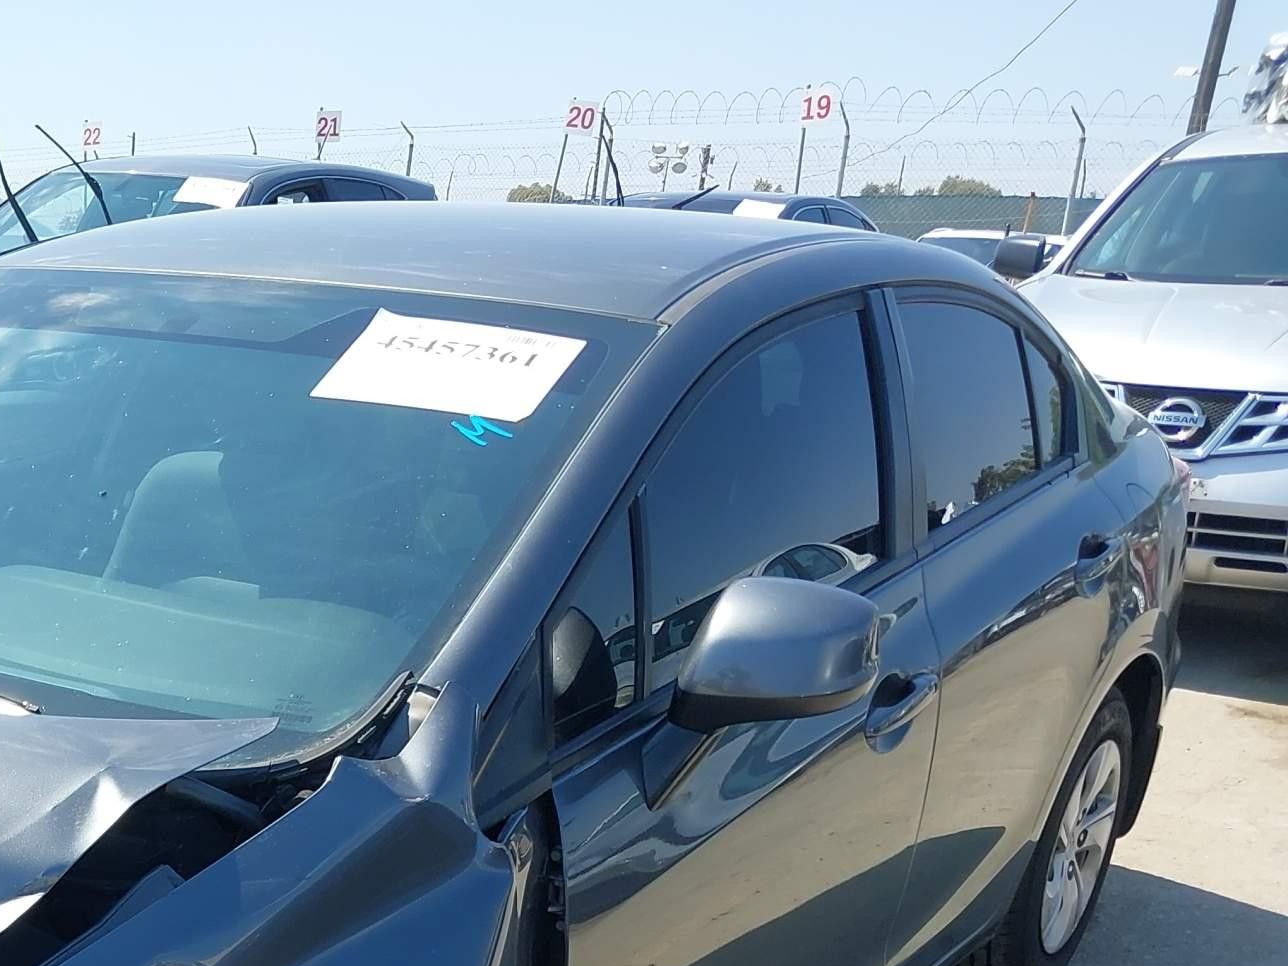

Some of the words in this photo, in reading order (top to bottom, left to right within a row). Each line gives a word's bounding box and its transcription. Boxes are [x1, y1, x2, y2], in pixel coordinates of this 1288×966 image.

[566, 105, 595, 130] 20
[801, 94, 832, 121] 19
[83, 127, 101, 146] 22
[316, 117, 340, 138] 21
[377, 335, 539, 367] 45457361
[1152, 414, 1199, 425] NISSAN
